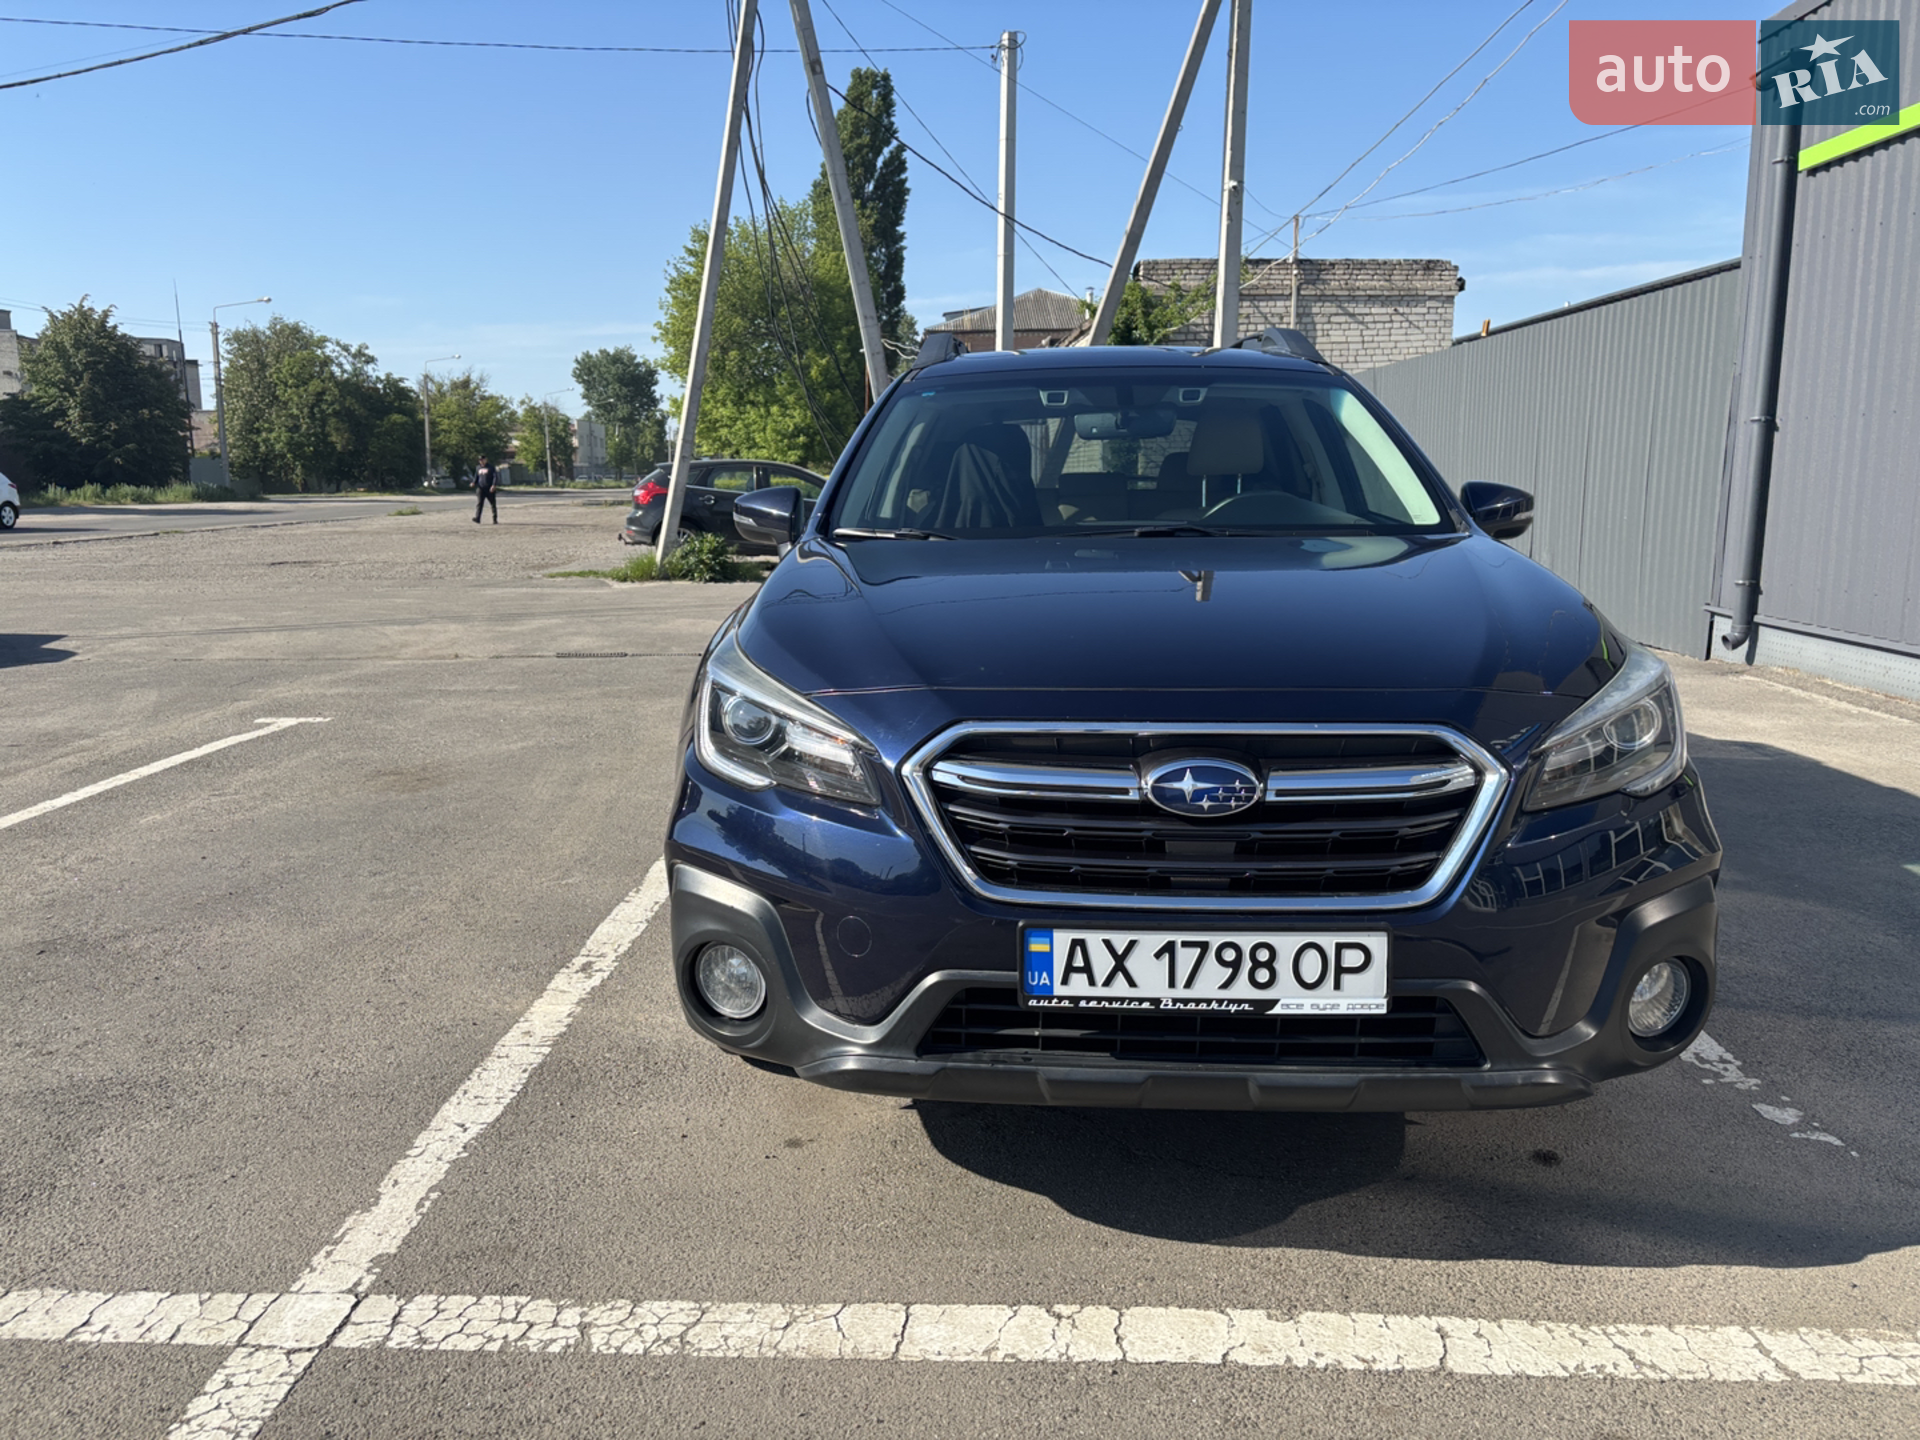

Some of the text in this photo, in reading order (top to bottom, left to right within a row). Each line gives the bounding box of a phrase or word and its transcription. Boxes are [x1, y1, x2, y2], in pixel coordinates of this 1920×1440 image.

[1060, 937, 1372, 991] AX 1798 OP
[1028, 971, 1051, 986] UA
[1028, 998, 1074, 1007] auto
[1078, 999, 1155, 1009] service
